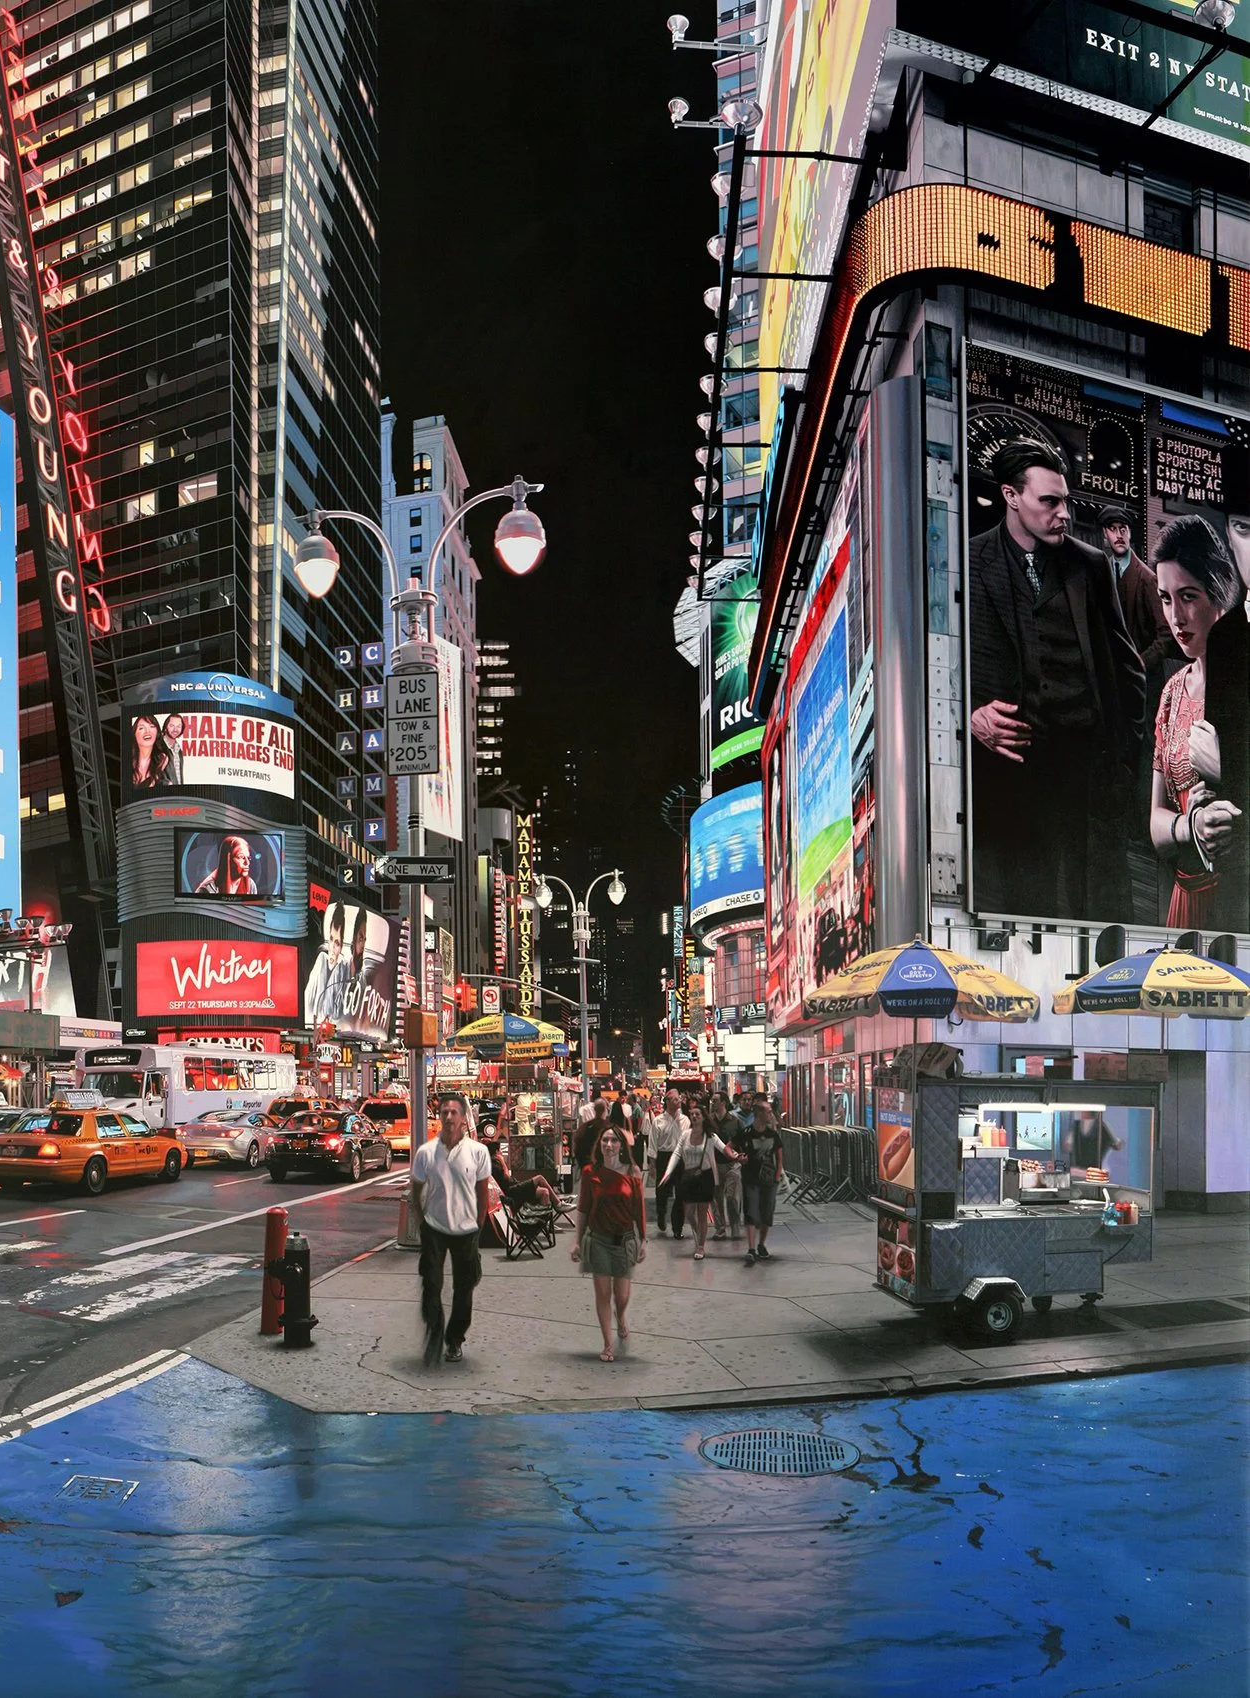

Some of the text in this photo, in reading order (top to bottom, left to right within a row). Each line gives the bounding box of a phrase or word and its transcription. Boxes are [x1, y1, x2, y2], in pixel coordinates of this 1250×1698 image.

[1085, 28, 1140, 62] EXIT
[1149, 52, 1160, 69] 2
[7, 238, 28, 278] &
[20, 322, 77, 613] YOUNG
[1156, 437, 1164, 448] 3
[1157, 452, 1200, 475] SPORTS
[1081, 471, 1139, 498] FROLIC
[1156, 466, 1199, 487] CIRCUS
[1156, 480, 1184, 496] BABY
[171, 683, 266, 700] NBC UNIVERSAL
[400, 679, 426, 694] BUS
[396, 698, 431, 714] LANE
[720, 696, 755, 731] RIC
[396, 720, 431, 731] TOW &
[182, 715, 293, 753] HALF OF ALL
[402, 732, 424, 744] FINE
[181, 740, 294, 771] MARRIAGES END
[218, 767, 271, 782] IN SWEATPANTS
[396, 763, 431, 772] MINIMUM
[153, 806, 201, 817] SHARP
[516, 814, 532, 895] MADAME
[387, 865, 444, 875] ONE WAY
[726, 894, 752, 907] CHASE
[170, 943, 271, 997] Whitney
[839, 959, 892, 978] SABRETT
[948, 964, 985, 975] SABRETT
[1156, 966, 1214, 977] SABRETT
[169, 1002, 186, 1010] SEPT
[344, 982, 360, 1016] GO
[359, 984, 391, 1027] FORTH
[807, 995, 872, 1015] SABRETT
[925, 998, 942, 1006] ROLL
[1148, 990, 1248, 1008] SABRETT
[507, 1045, 549, 1056] SABRETT
